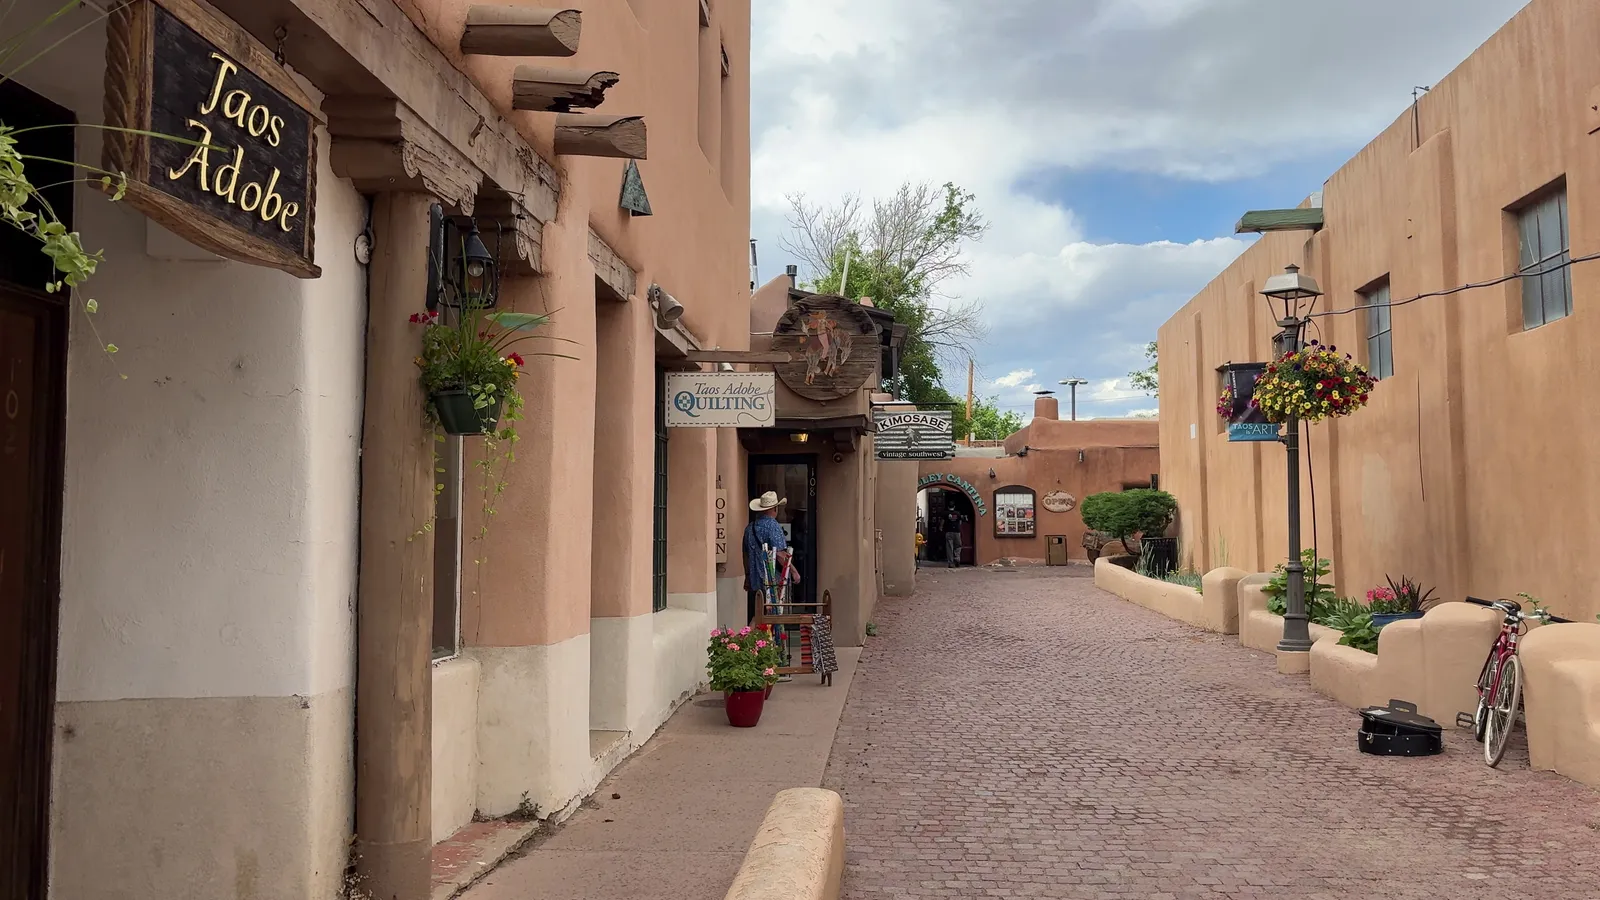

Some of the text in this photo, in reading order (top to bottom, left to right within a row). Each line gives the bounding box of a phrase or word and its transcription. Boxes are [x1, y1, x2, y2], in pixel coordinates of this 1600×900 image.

[200, 51, 285, 147] Taos
[167, 118, 299, 232] Adobe
[673, 390, 766, 418] QUILTING
[694, 382, 761, 395] Taos Adobe
[879, 414, 947, 431] KIMOSABE
[1251, 424, 1276, 435] ART
[946, 473, 987, 517] CANTINA
[715, 497, 727, 555] OPEN
